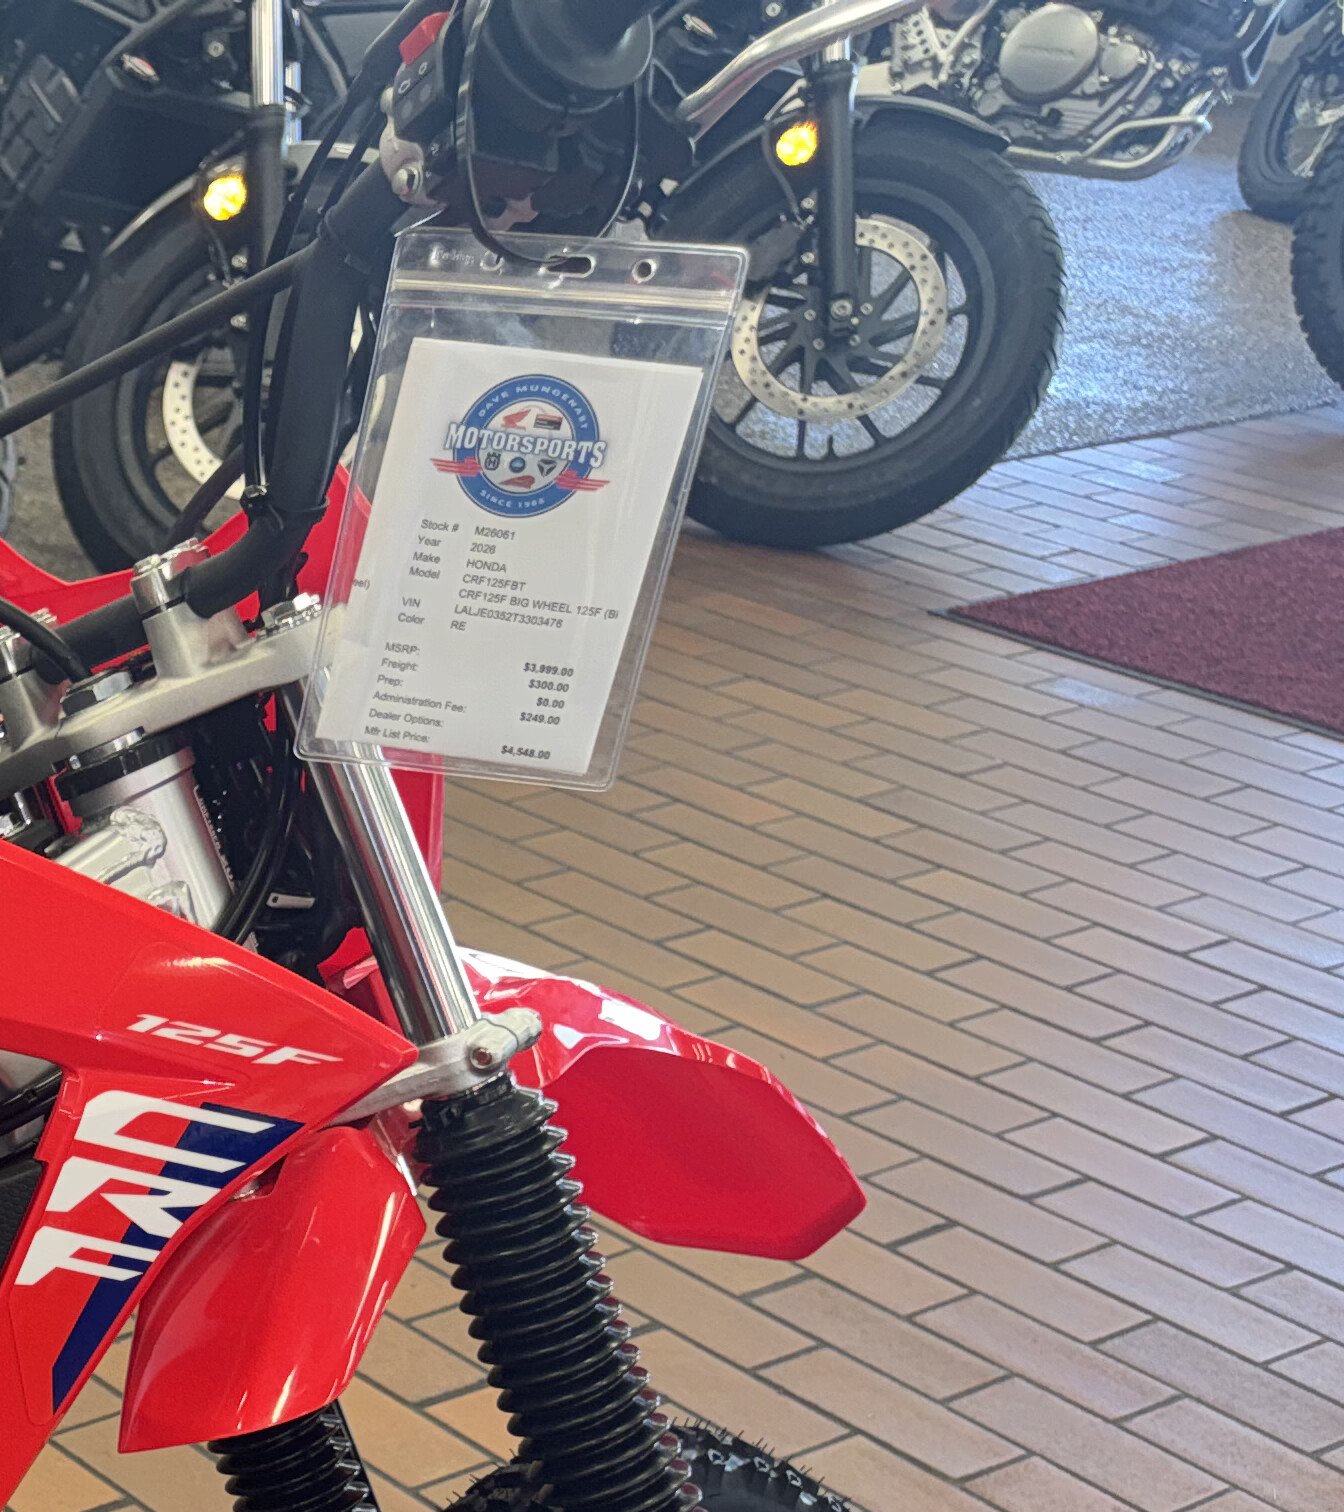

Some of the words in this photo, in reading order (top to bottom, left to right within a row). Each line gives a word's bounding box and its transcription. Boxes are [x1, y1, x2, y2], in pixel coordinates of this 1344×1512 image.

[478, 391, 510, 418] DAVE
[515, 384, 588, 430] MUNGENAST
[444, 422, 607, 469] MOTORSPORTS
[479, 489, 512, 508] SINCE
[417, 534, 442, 547] Year
[420, 518, 449, 532] Stock
[451, 523, 460, 532] #
[412, 551, 441, 564] Make
[466, 558, 507, 573] HONDA
[408, 566, 441, 579] Model
[462, 573, 527, 592] CRF125FBT
[401, 595, 421, 608] VIN
[458, 588, 507, 604] CRF125F
[509, 596, 530, 609] BIG
[532, 599, 572, 614] WHEEL
[576, 605, 602, 618] 125F
[397, 611, 425, 625] Color
[449, 619, 467, 632] RE
[380, 657, 418, 672] Freight:
[528, 678, 569, 693] $300.00
[384, 641, 420, 655] MSRP:
[522, 661, 574, 678] $3,999.00
[376, 673, 404, 687] Prep:
[536, 697, 565, 709] $0.00
[368, 708, 400, 722] Dealer
[403, 713, 444, 728] Options:
[372, 690, 442, 710] Administration
[443, 700, 467, 713] Fee:
[519, 711, 561, 726] $249.00
[363, 725, 381, 736] Mfr
[382, 728, 401, 740] List
[402, 731, 431, 744] Price:
[500, 744, 551, 760] $4,548.00
[127, 1013, 344, 1065] 125F
[14, 1089, 276, 1287] CRF
